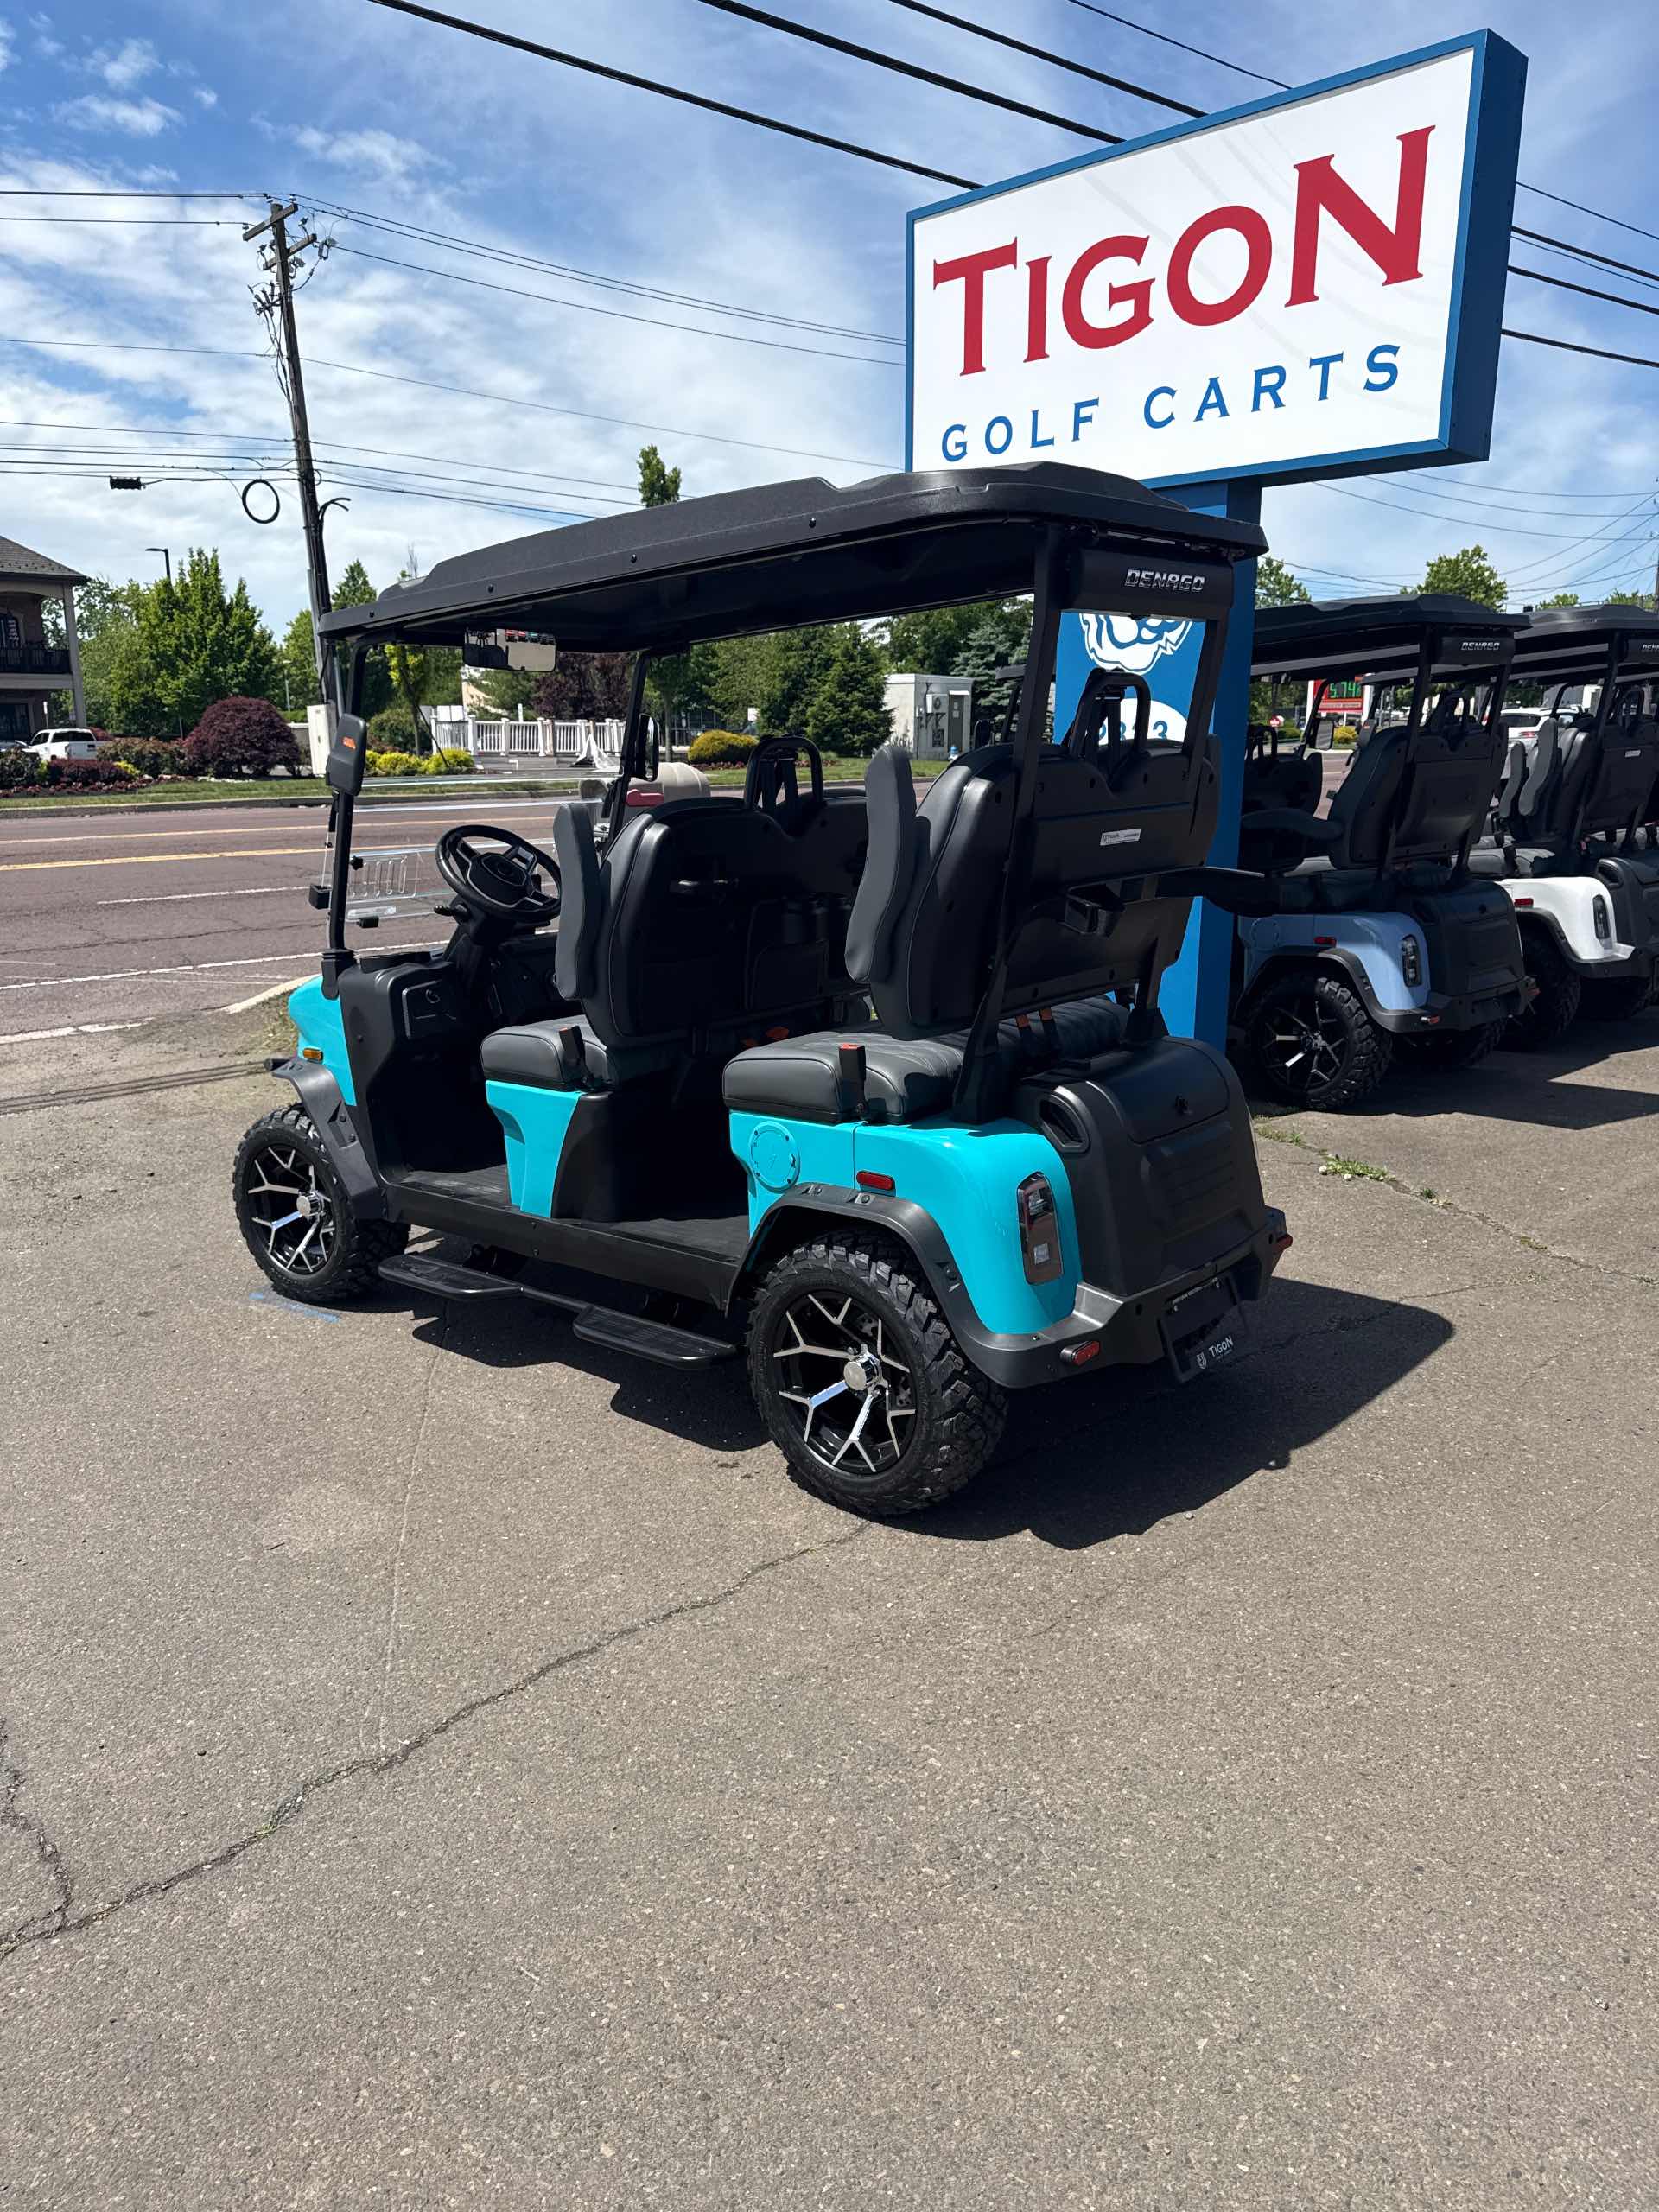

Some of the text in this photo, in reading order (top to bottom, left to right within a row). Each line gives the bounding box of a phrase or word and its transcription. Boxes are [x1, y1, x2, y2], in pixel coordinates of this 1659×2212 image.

[933, 125, 1435, 376] TIGON
[942, 345, 1400, 462] GOLF CARTS
[1125, 569, 1205, 592] DENAGO
[1208, 1335, 1234, 1357] TIGON
